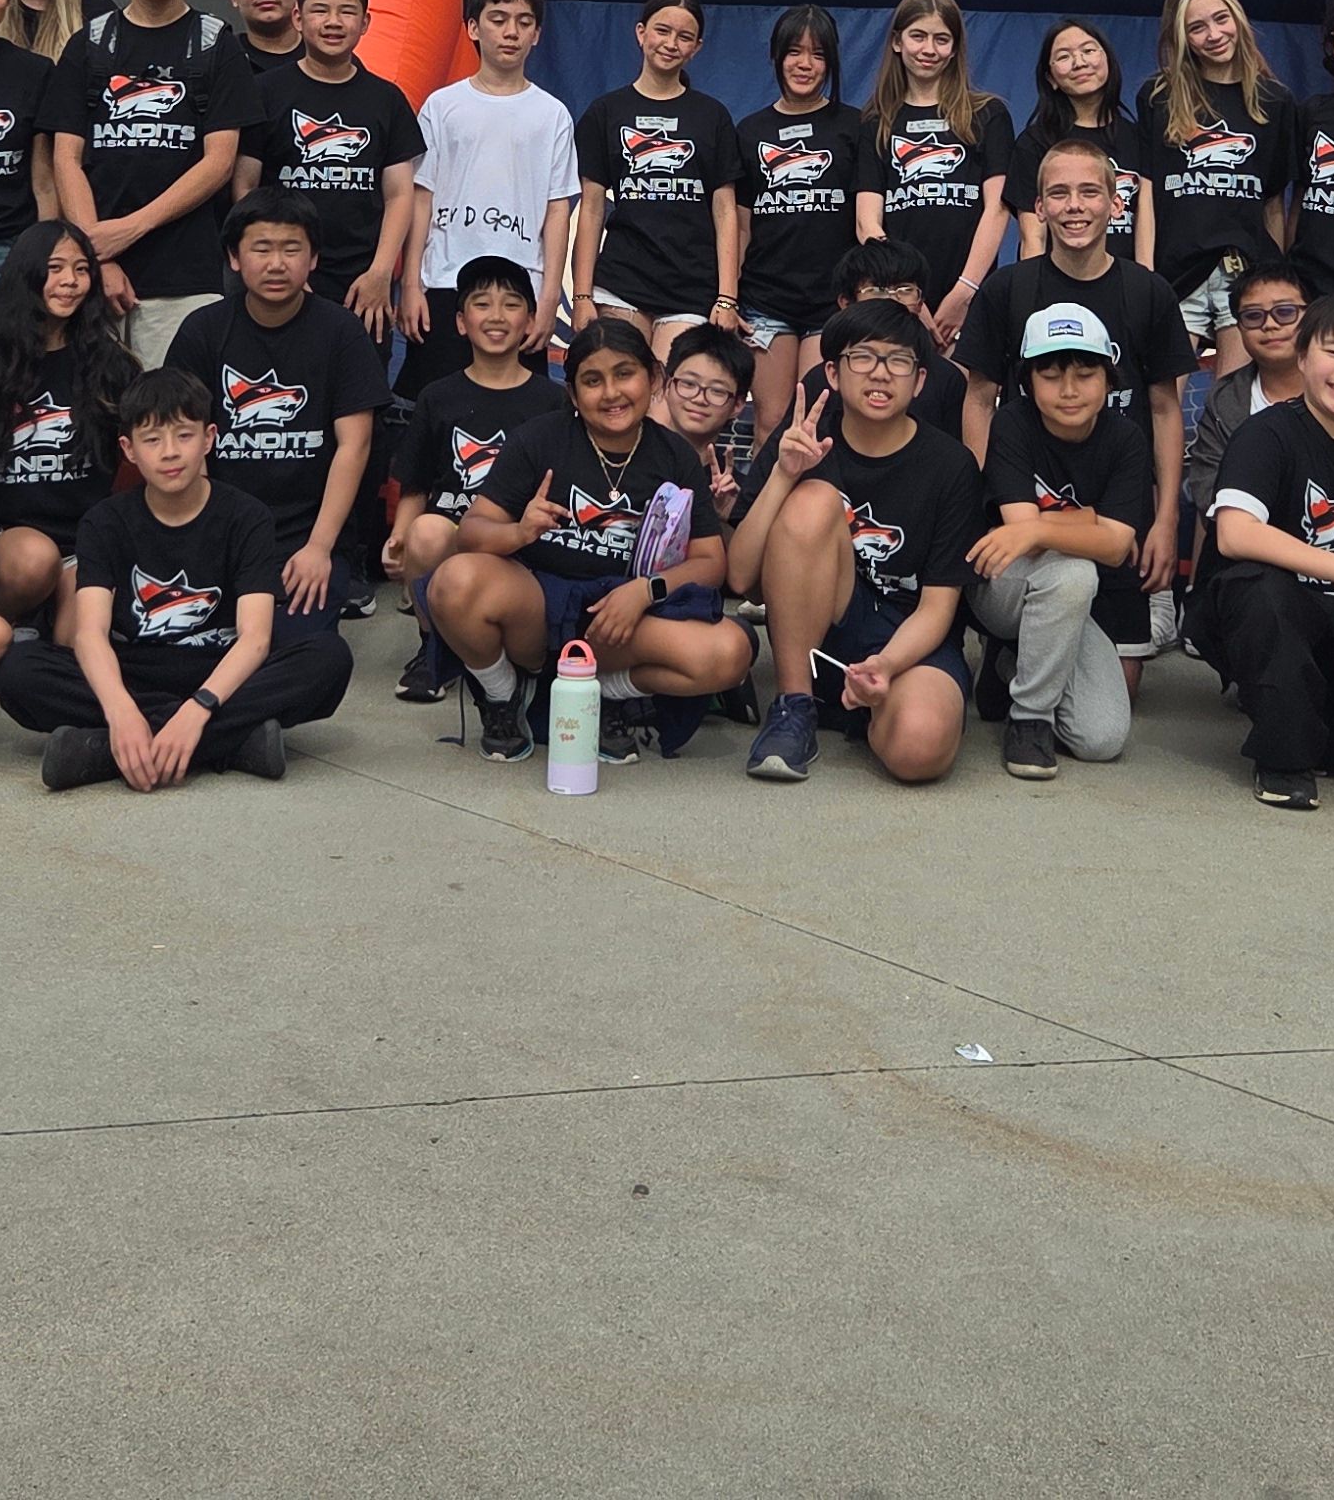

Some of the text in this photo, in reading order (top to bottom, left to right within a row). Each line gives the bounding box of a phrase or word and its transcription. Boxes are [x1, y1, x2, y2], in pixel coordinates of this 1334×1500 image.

[619, 192, 700, 202] ASKETBALL
[483, 207, 531, 242] GOAL
[217, 449, 316, 459] ASKETBALL
